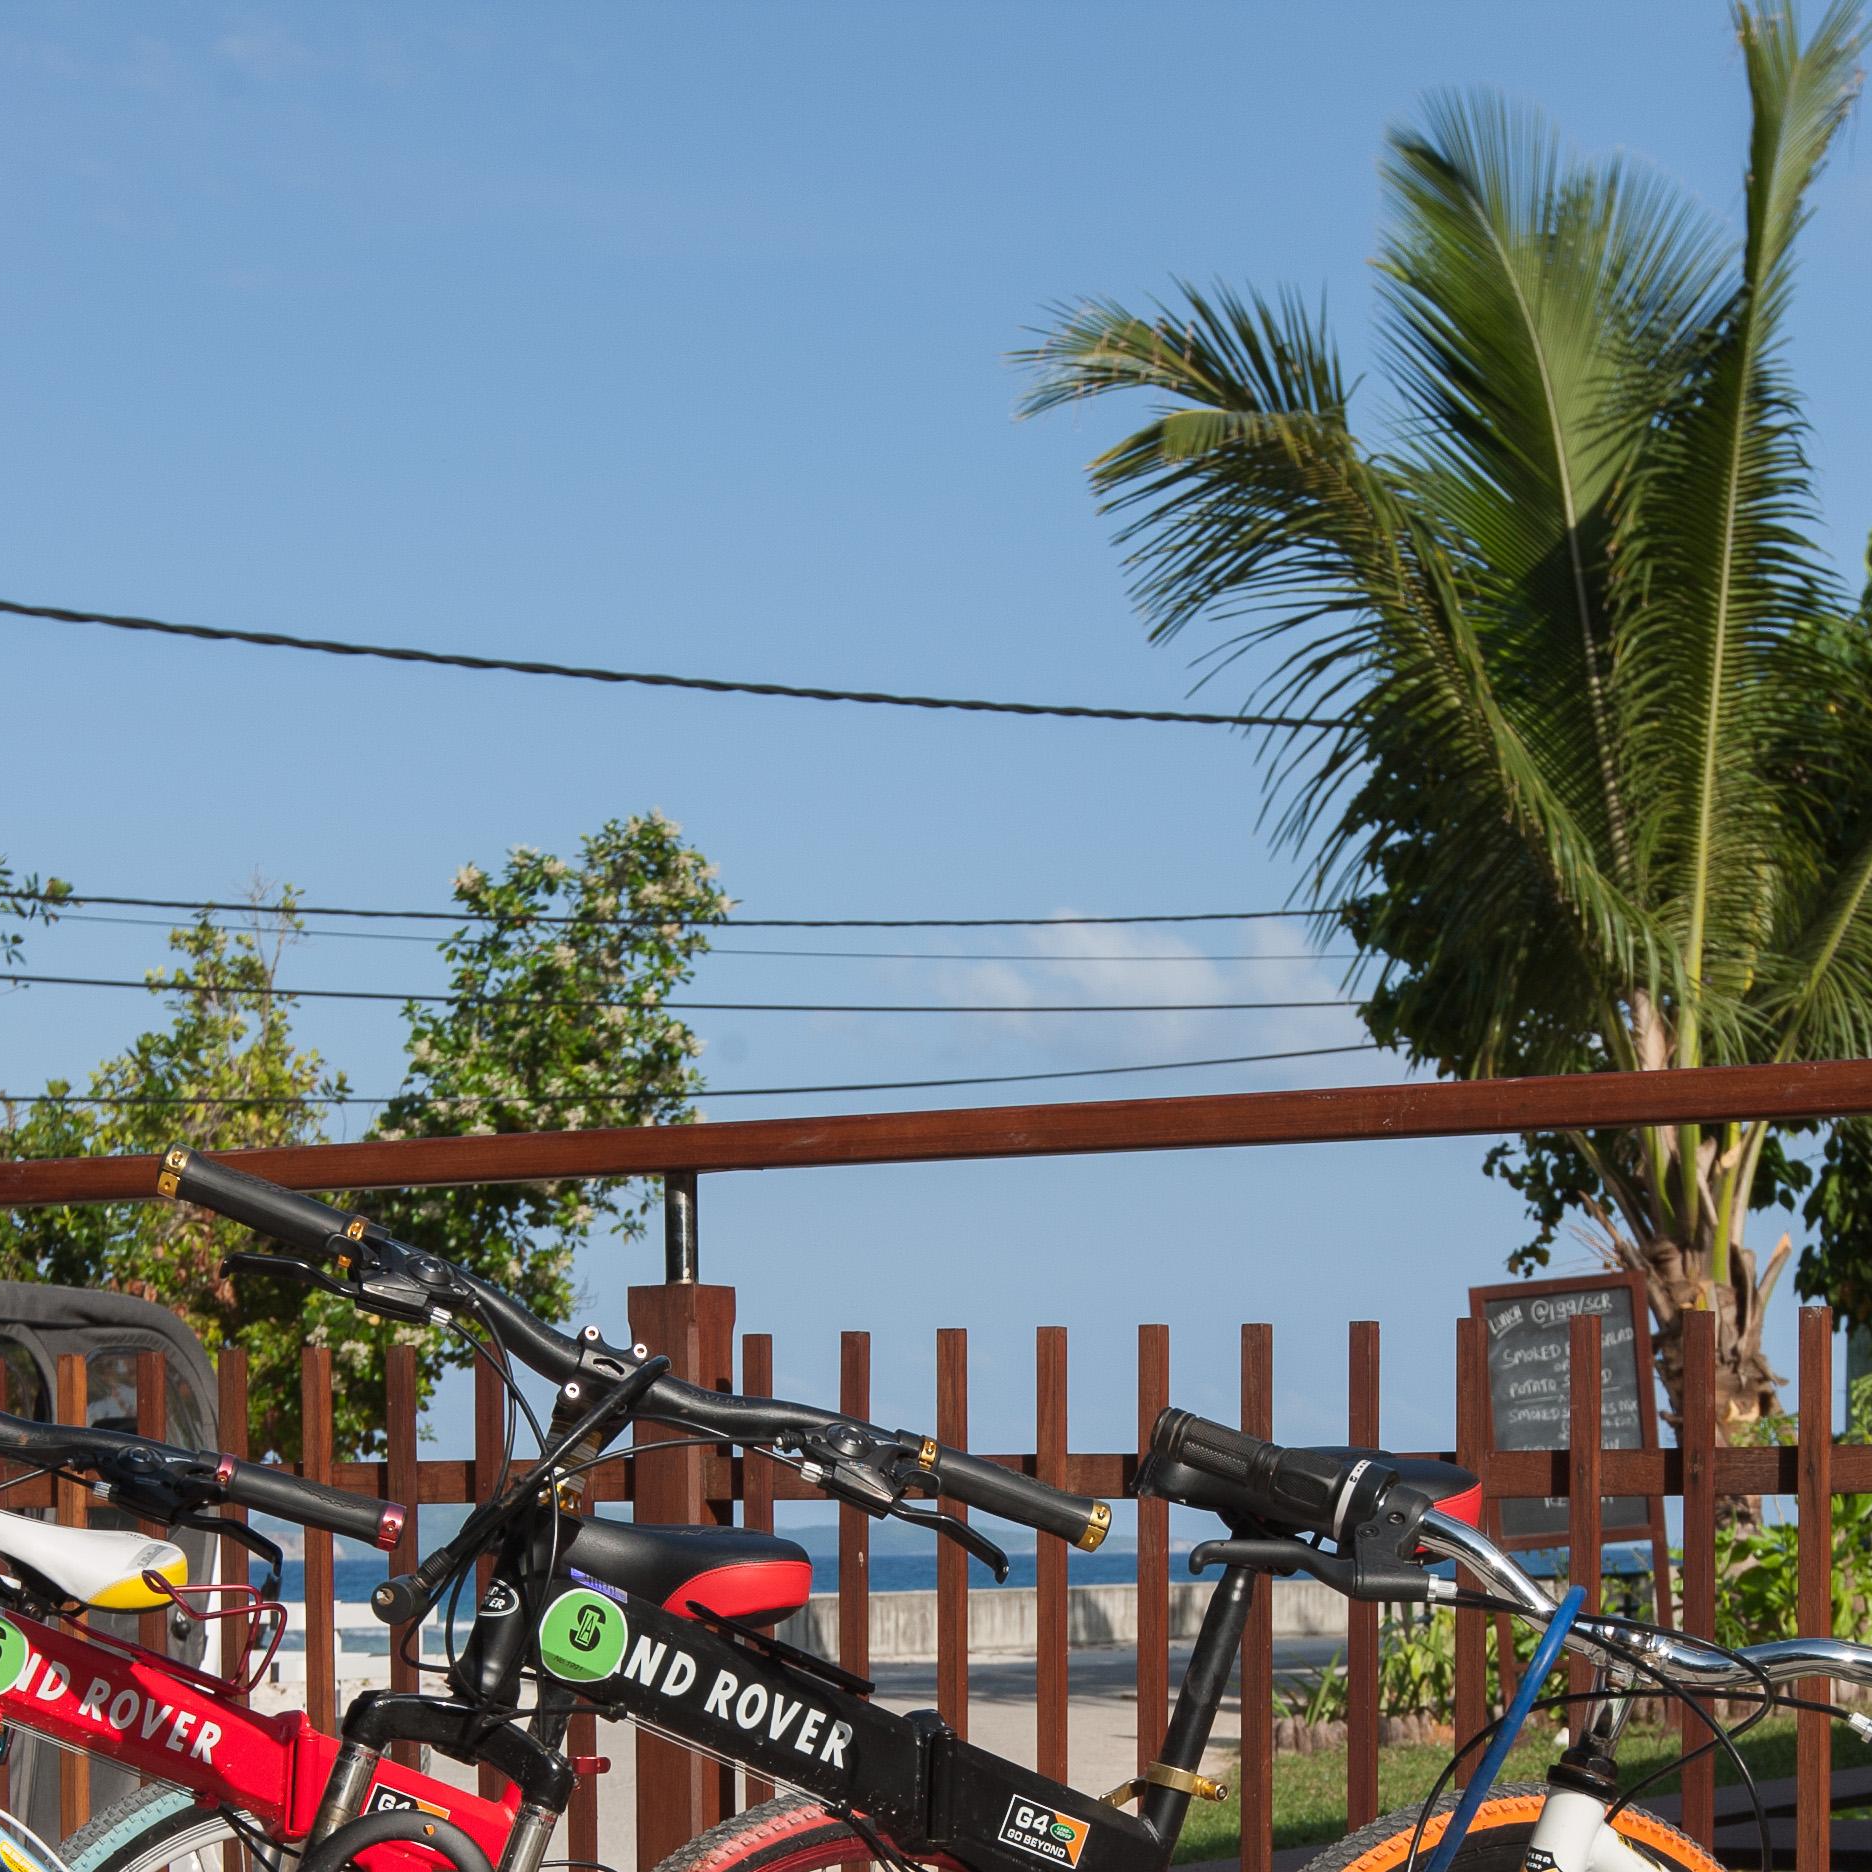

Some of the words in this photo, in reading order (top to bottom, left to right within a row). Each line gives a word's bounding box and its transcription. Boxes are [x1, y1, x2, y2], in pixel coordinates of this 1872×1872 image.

[1488, 1305, 1523, 1335] LUNCH
[1502, 1343, 1561, 1368] SMOKED
[1509, 1378, 1558, 1398] POTATO
[78, 1677, 222, 1765] ROVER
[704, 1669, 854, 1769] ROVER
[1015, 1806, 1050, 1836] G4
[1006, 1828, 1023, 1842] GO
[1023, 1834, 1066, 1859] BEYOND
